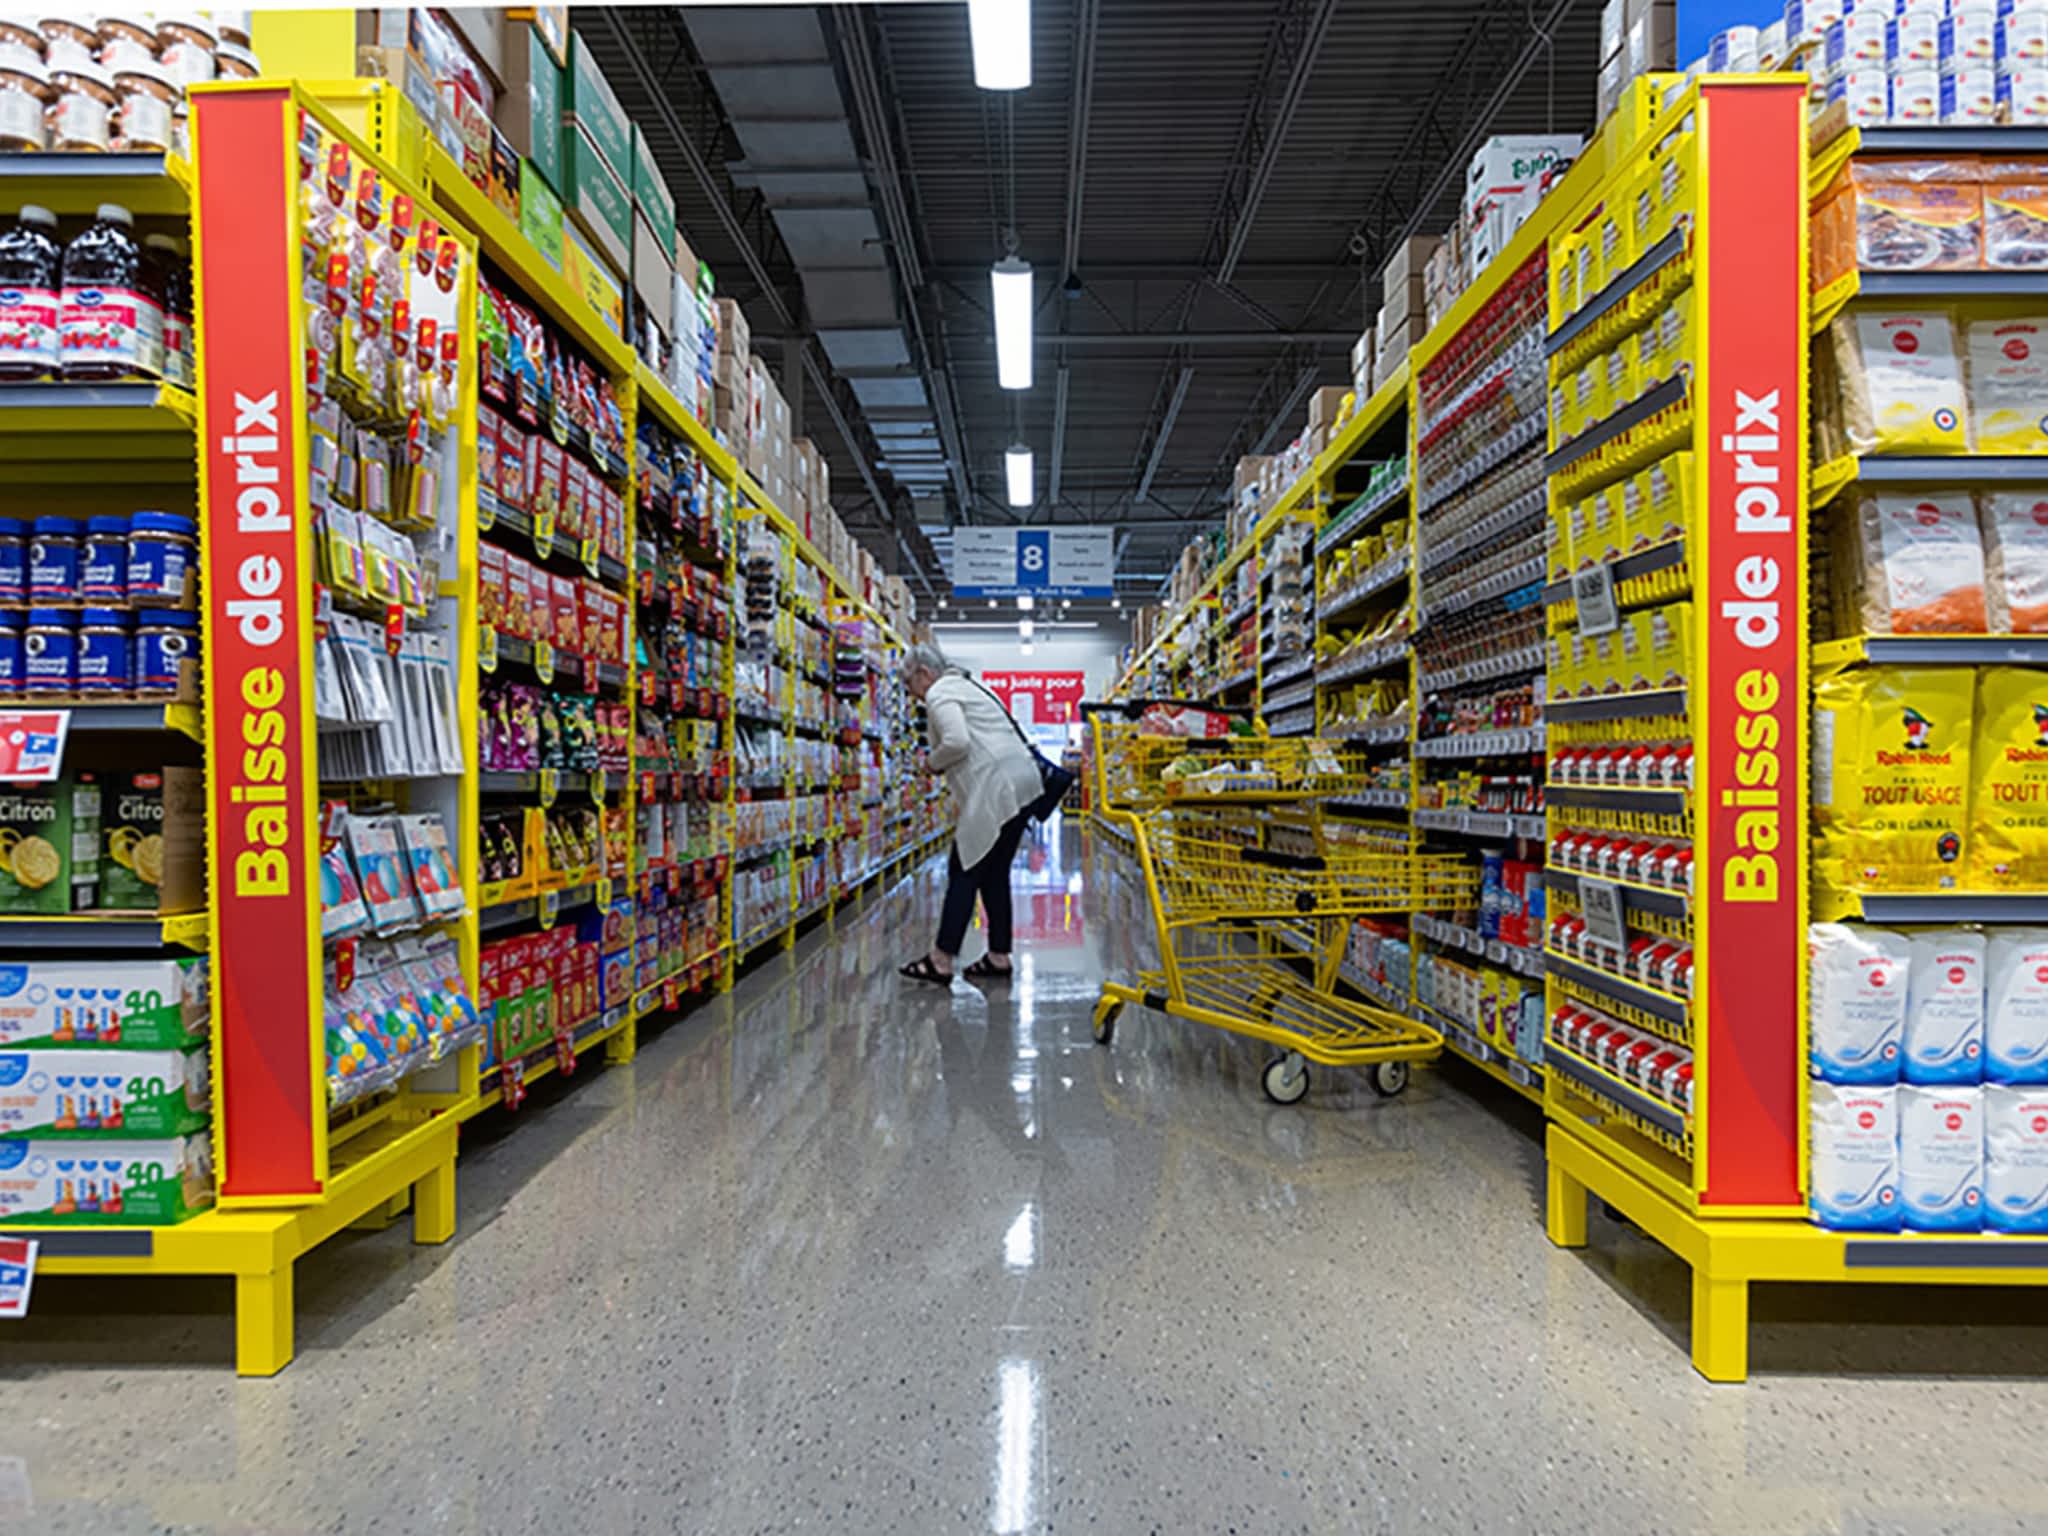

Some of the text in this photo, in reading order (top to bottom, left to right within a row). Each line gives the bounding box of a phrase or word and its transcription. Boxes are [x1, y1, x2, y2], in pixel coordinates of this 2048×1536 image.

[1023, 545, 1043, 570] 8
[222, 390, 292, 897] Baisse de prix
[1722, 388, 1792, 902] Baisse de prix
[1862, 785, 1962, 805] TOUT USAGE
[1991, 783, 2039, 802] TOUT
[0, 801, 56, 821] Citron
[118, 800, 164, 820] Citro
[125, 990, 162, 1015] 40
[127, 1077, 165, 1103] 40
[127, 1162, 164, 1187] 40
